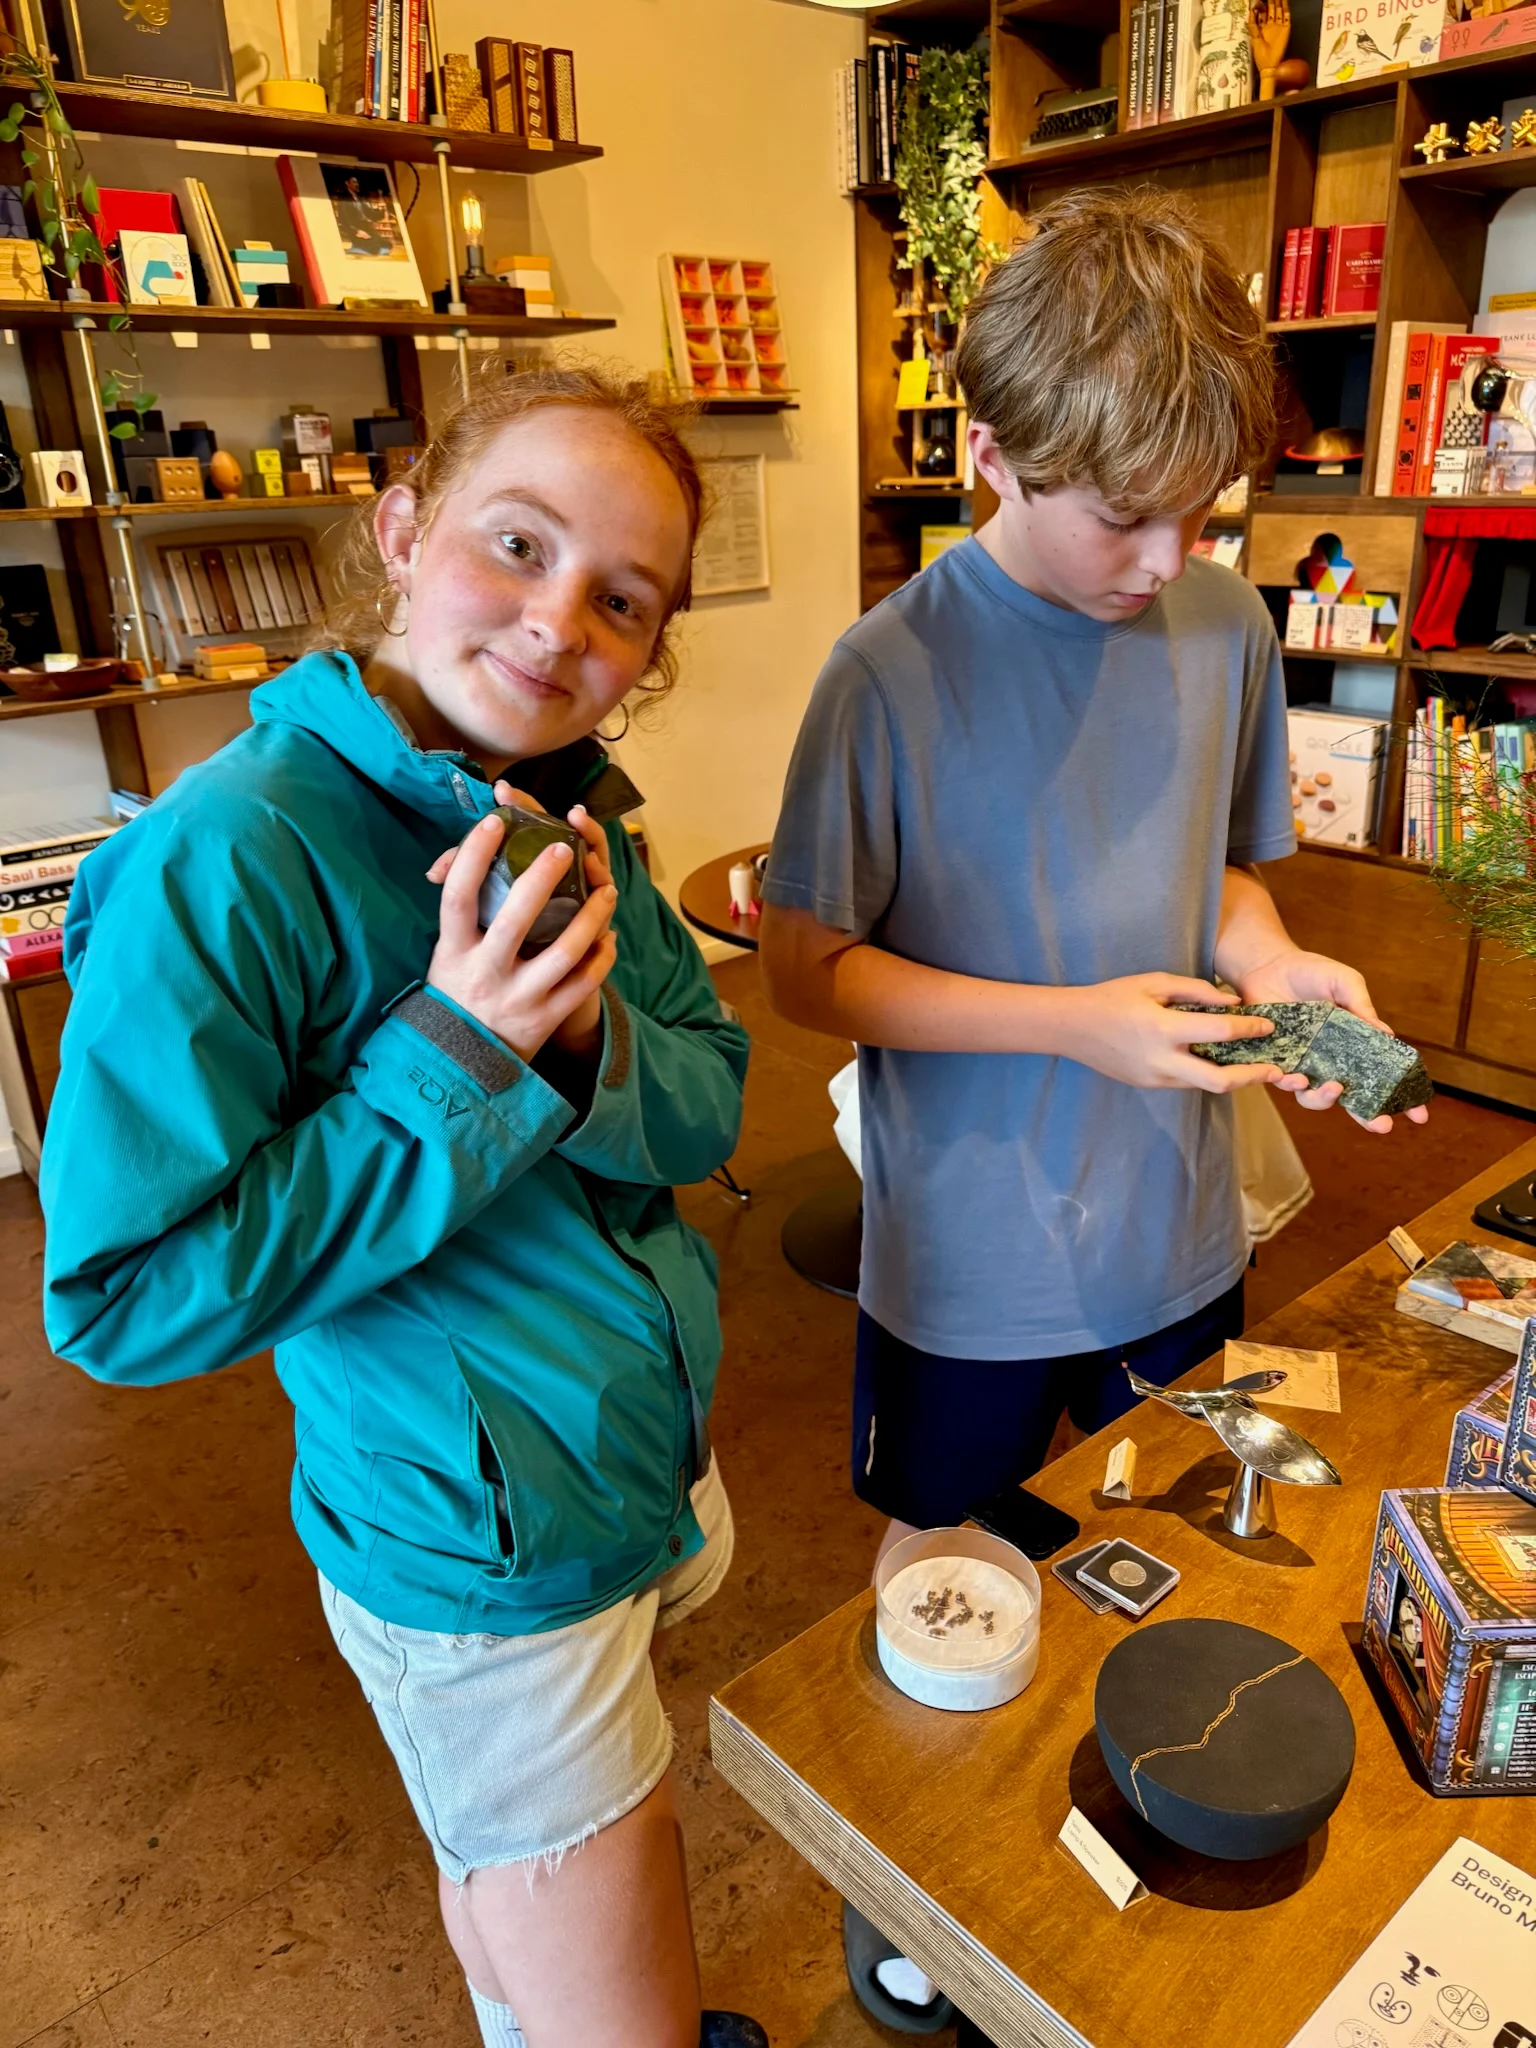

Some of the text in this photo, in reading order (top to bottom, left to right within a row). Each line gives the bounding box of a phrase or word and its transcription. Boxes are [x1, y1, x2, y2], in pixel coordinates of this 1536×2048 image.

[1166, 22, 1175, 53] BOOK
[1325, 7, 1368, 31] BIRD
[1131, 31, 1139, 62] BOOK
[1147, 27, 1156, 57] BOOK
[1129, 69, 1138, 117] SYMBOLS
[1145, 65, 1154, 113] SYMBOLS
[1163, 61, 1172, 110] SYMBOLS
[0, 864, 75, 885] Saul Bass
[1388, 1523, 1444, 1637] HOUDINI
[1451, 1871, 1512, 1915] Bruno
[1462, 1857, 1533, 1907] Design
